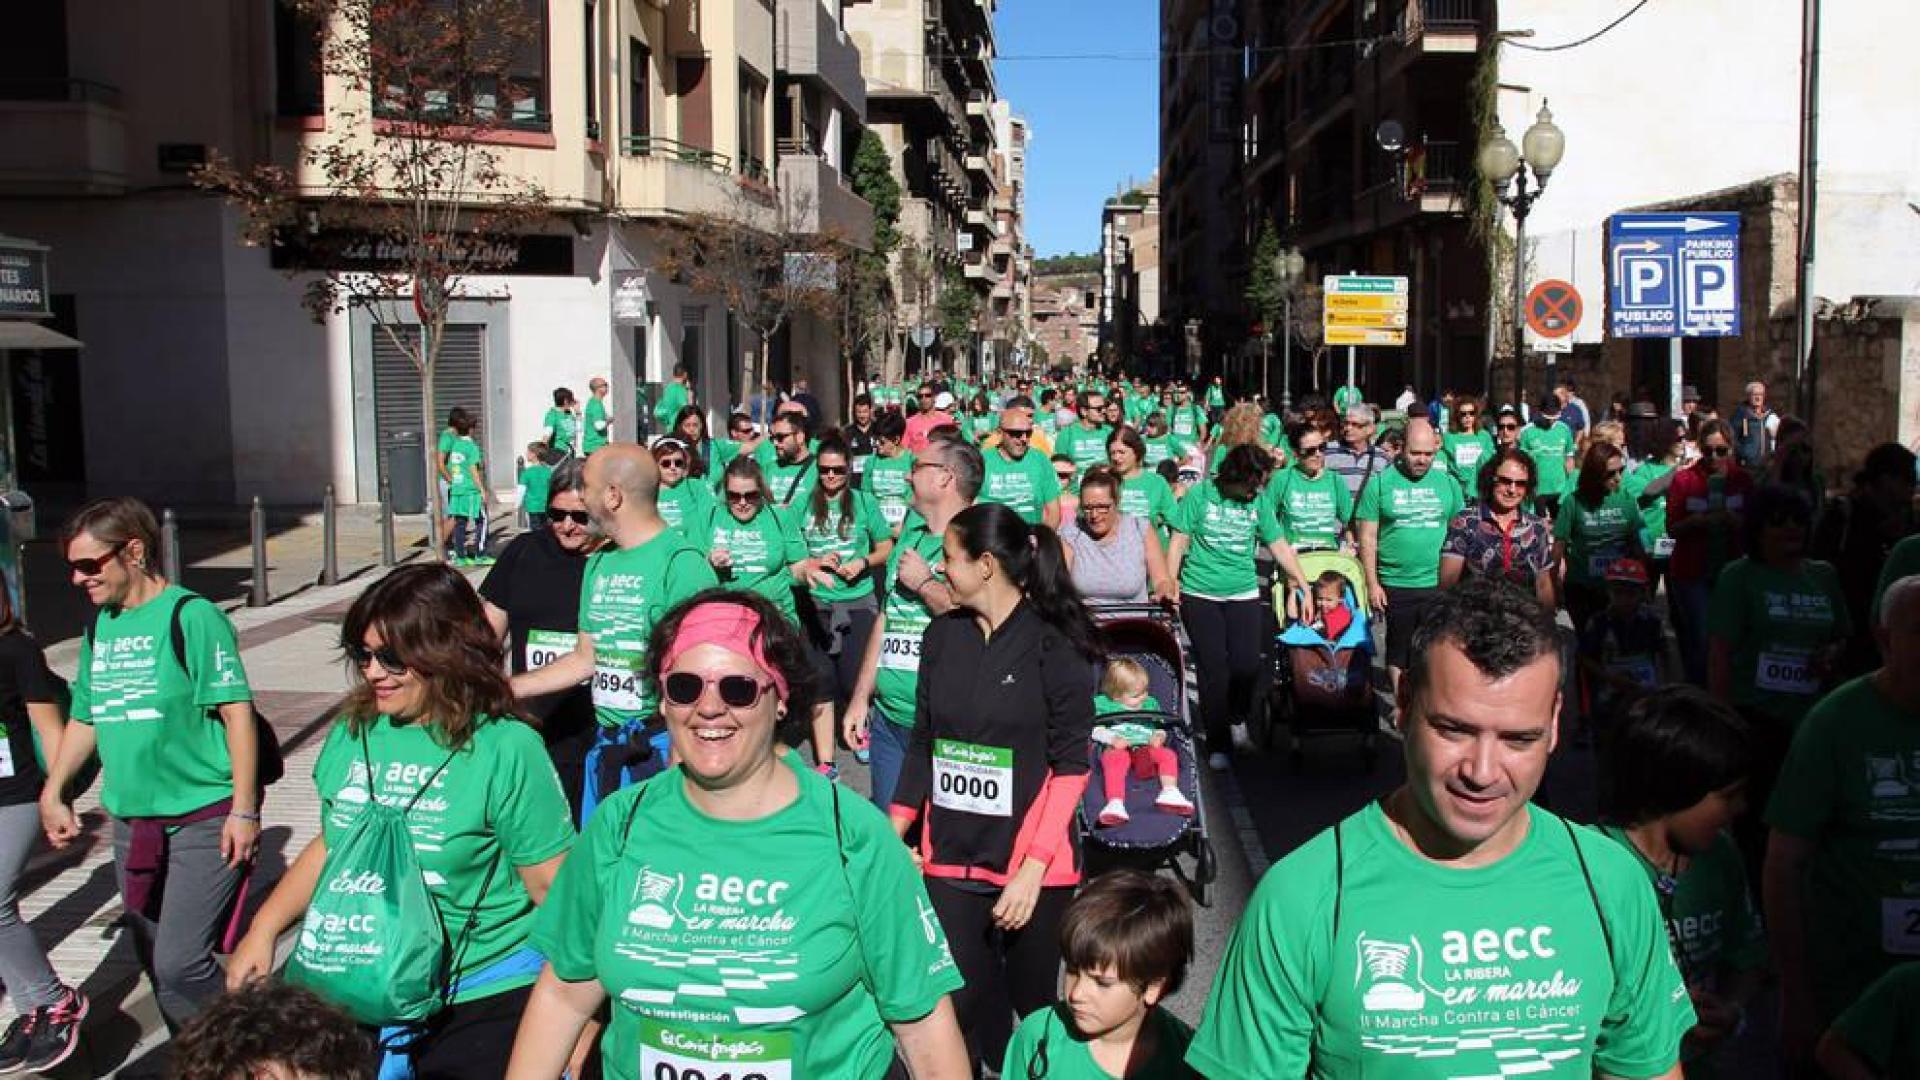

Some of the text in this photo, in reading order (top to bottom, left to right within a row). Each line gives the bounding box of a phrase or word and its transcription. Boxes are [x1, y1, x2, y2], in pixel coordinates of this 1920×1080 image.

[1631, 261, 1663, 303] P
[1695, 265, 1726, 307] P
[113, 635, 154, 652] aecc
[385, 761, 449, 788] aecc
[941, 772, 999, 802] 0000
[682, 933, 726, 946] Contra
[1442, 925, 1556, 965] aecc
[1443, 970, 1583, 1006] en marcha
[1444, 966, 1512, 982] LA RIBERA
[1374, 1014, 1440, 1029] Marcha
[1444, 1008, 1500, 1025] Contra
[1506, 1006, 1521, 1020] el
